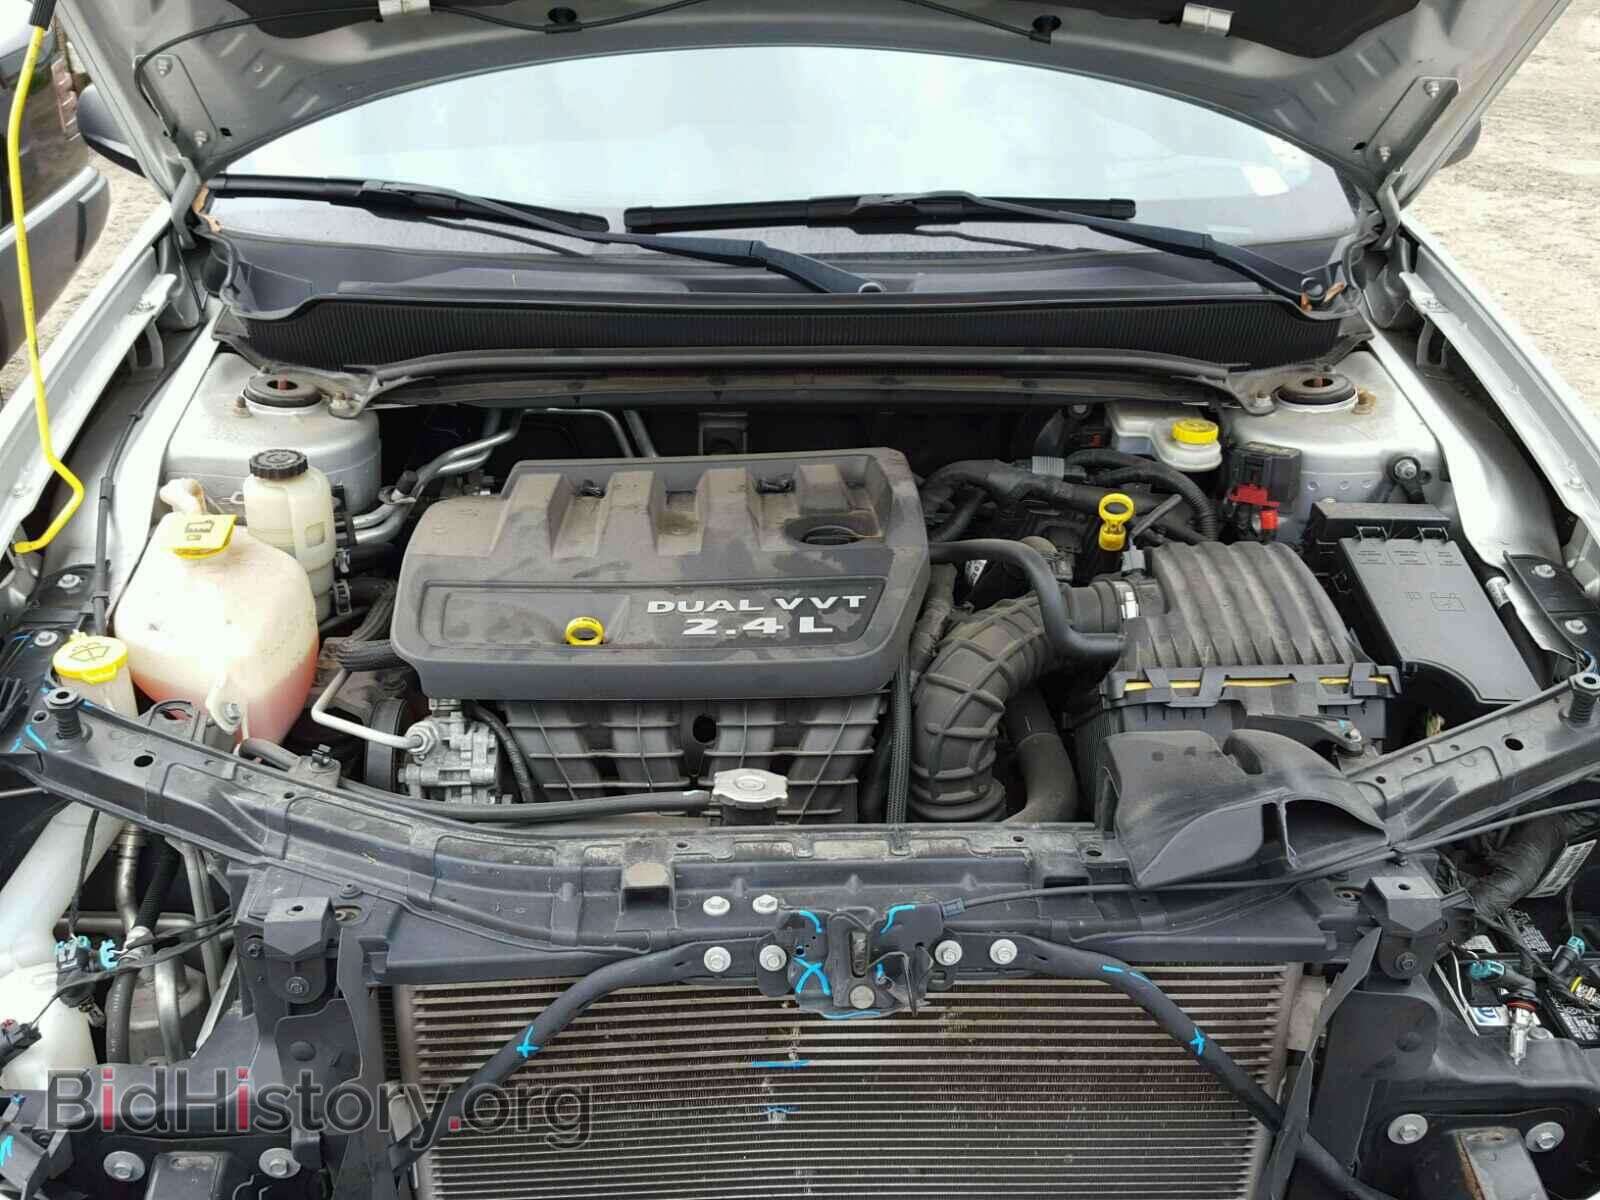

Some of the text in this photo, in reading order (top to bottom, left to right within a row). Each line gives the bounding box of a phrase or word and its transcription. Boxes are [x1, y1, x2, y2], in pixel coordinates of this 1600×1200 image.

[647, 595, 867, 614] DUAL VVT
[682, 616, 833, 636] 2.4L
